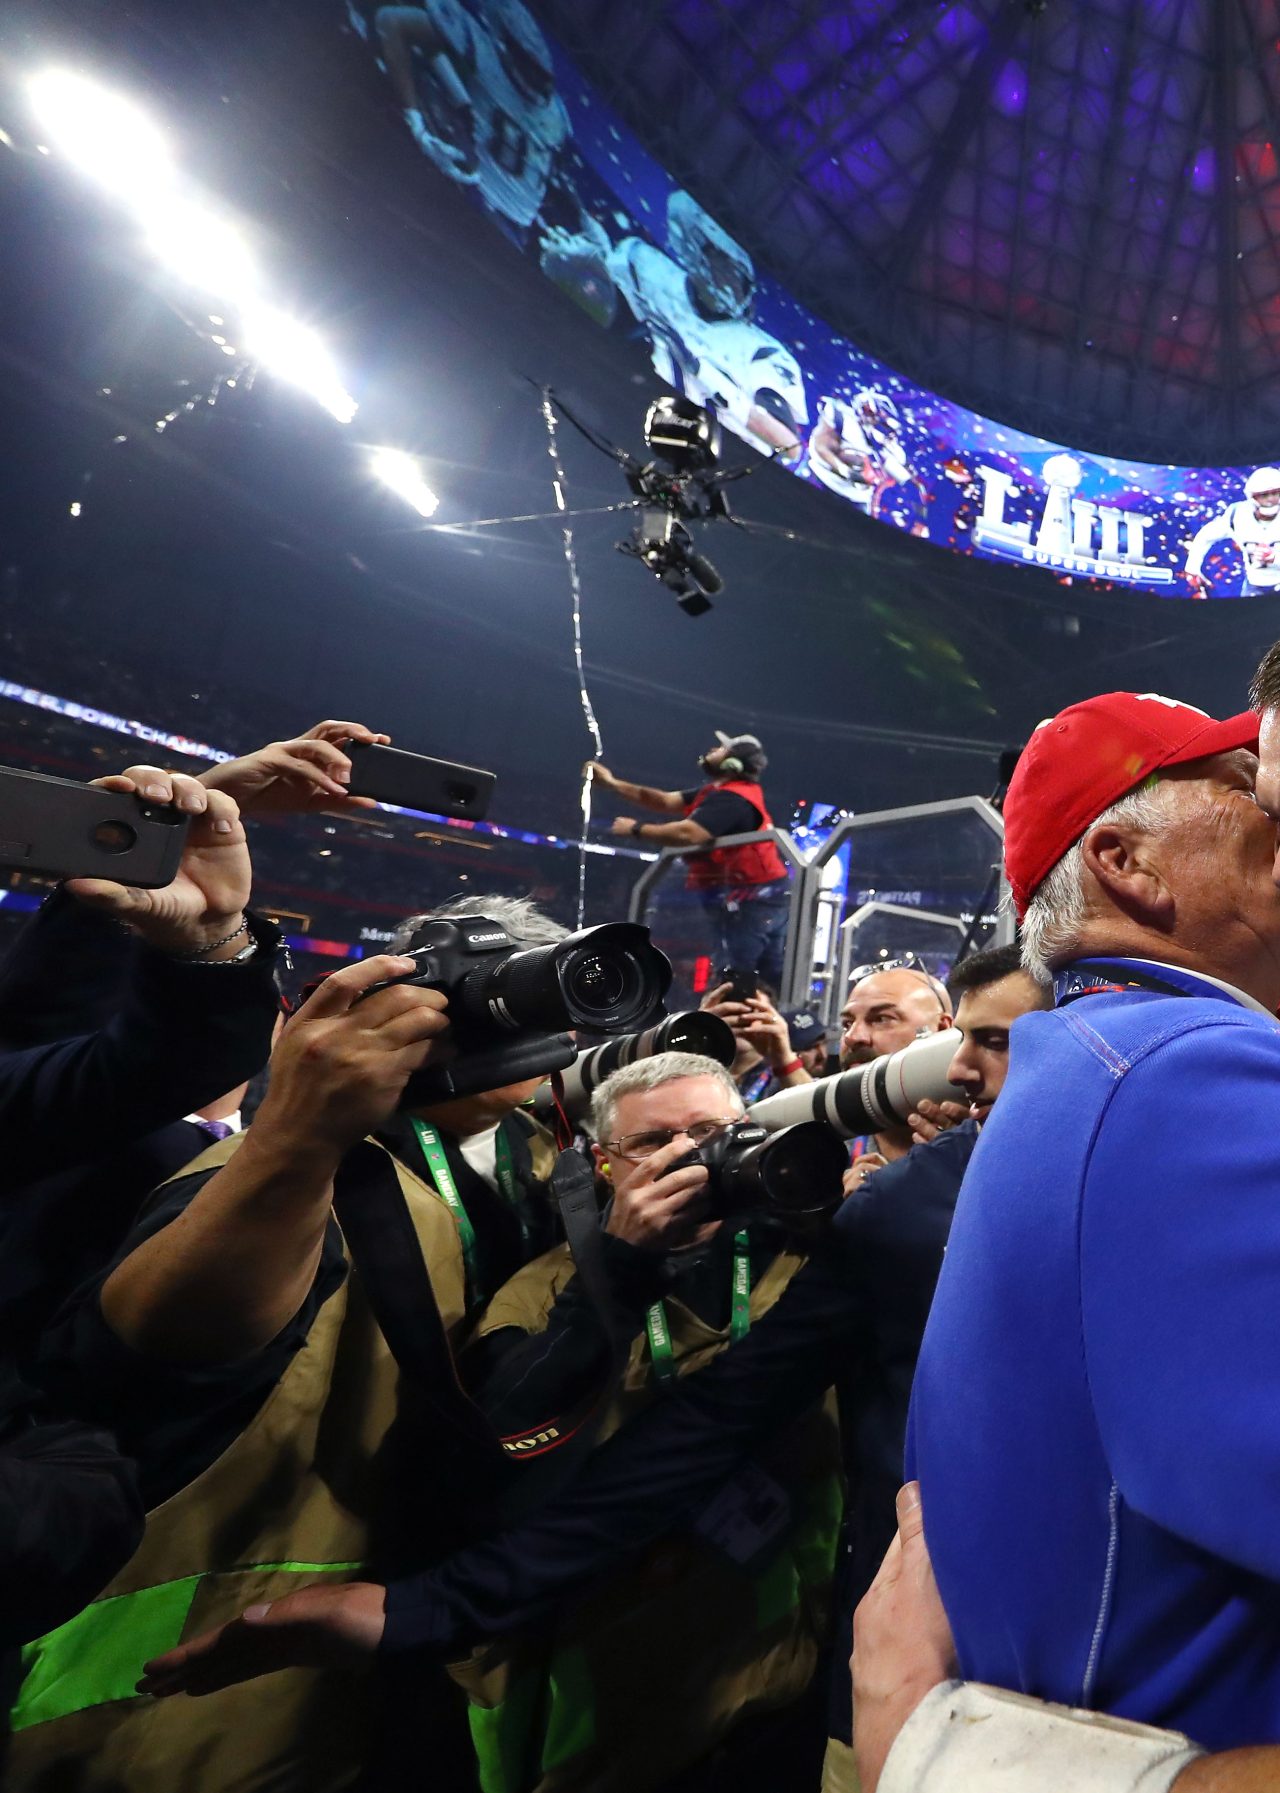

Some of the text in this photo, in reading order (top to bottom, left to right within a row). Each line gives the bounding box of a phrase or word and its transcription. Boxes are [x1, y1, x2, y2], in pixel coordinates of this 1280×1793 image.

[468, 931, 507, 944] Canon
[737, 1130, 764, 1139] Canon
[435, 1168, 459, 1207] GAMEDAY
[736, 1257, 747, 1295] GAMEDAY
[649, 1304, 665, 1347] GAMEDAY
